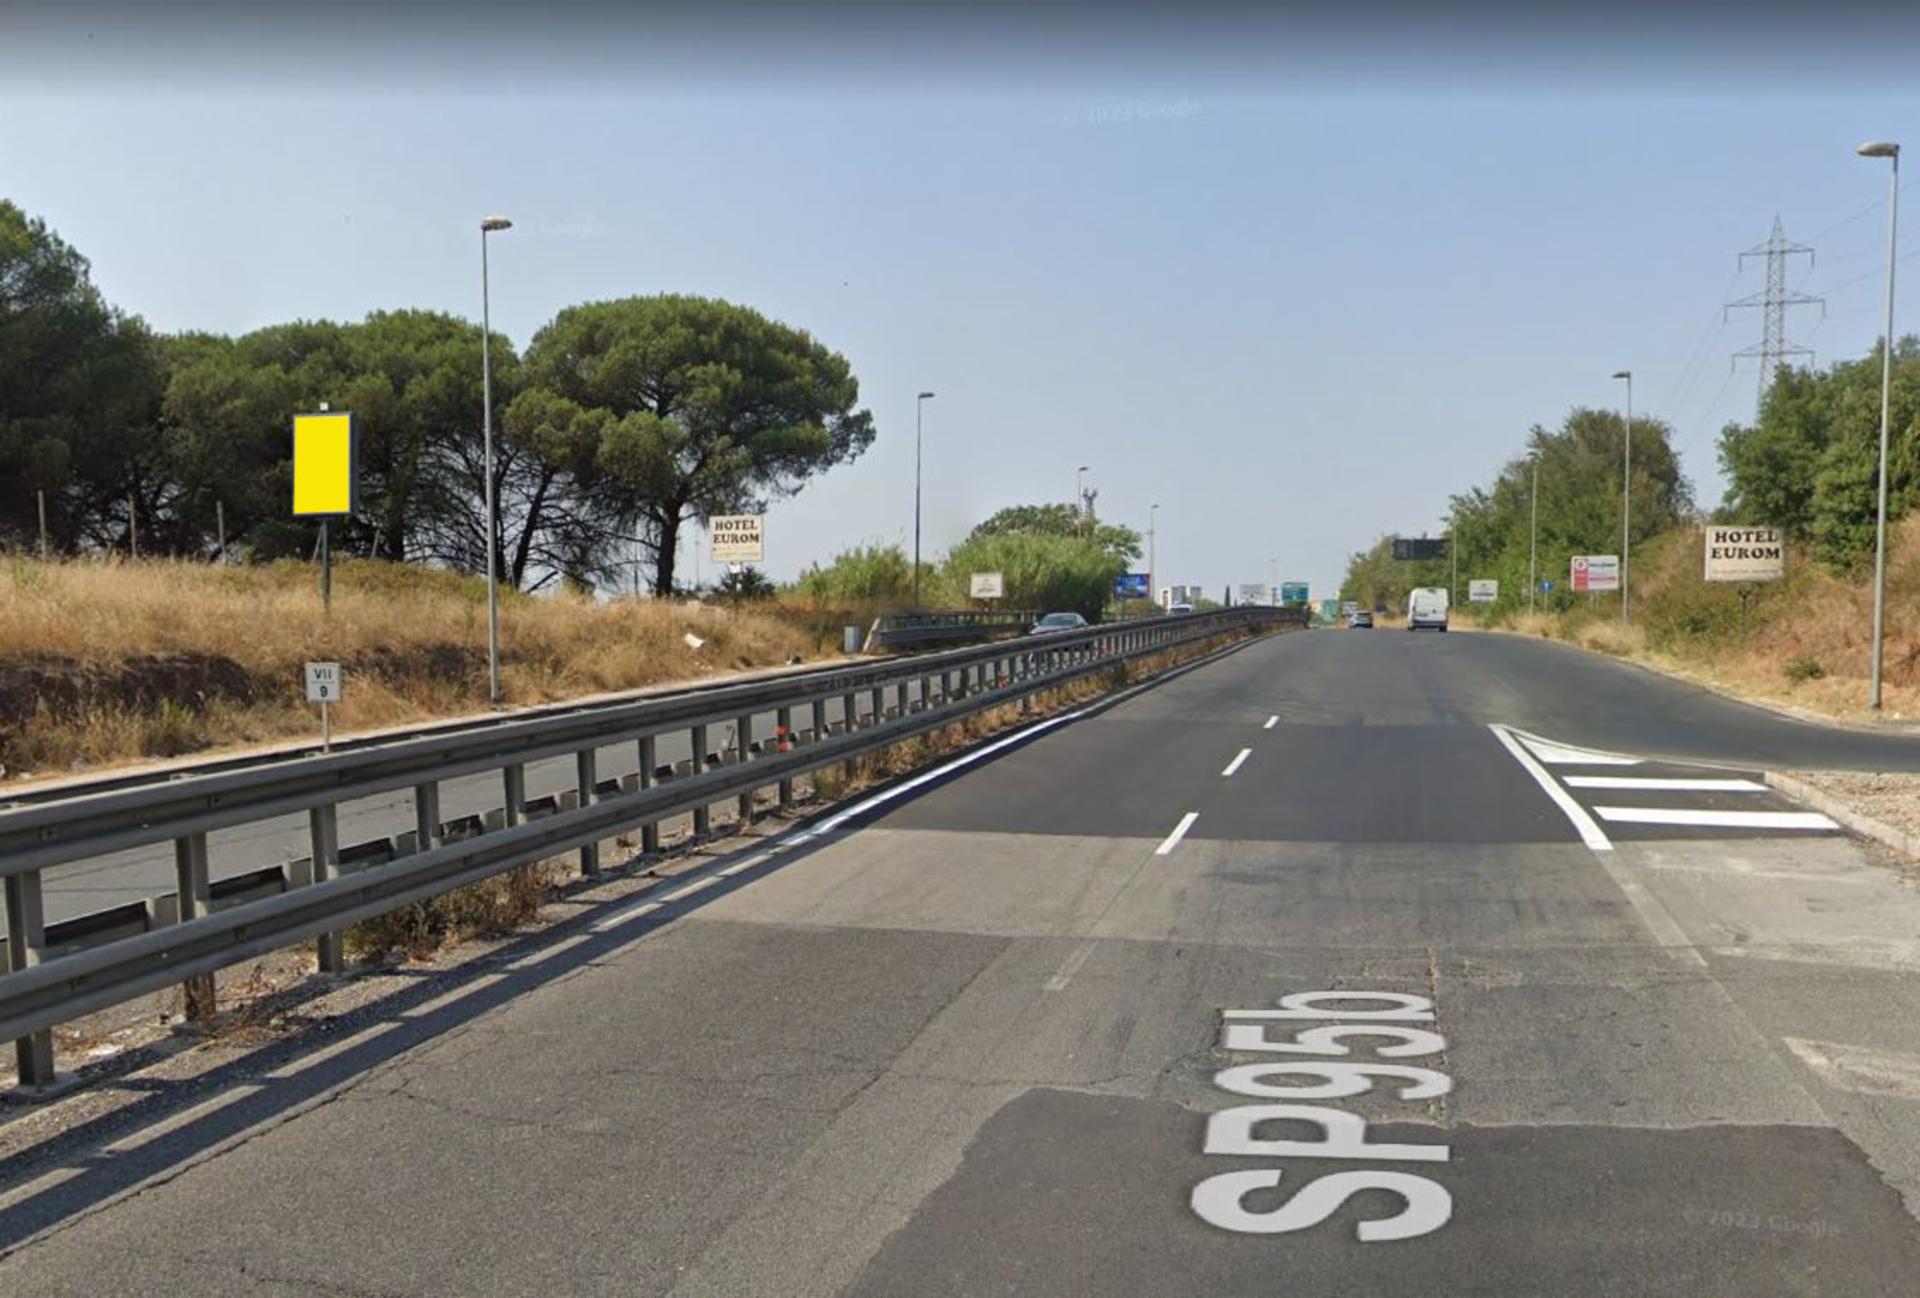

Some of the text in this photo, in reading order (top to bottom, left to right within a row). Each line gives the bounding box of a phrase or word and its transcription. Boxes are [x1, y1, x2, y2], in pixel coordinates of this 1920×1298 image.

[715, 519, 758, 531] HOTEL
[713, 533, 760, 544] EUROM
[1715, 530, 1778, 543] HOTEL
[1711, 547, 1780, 560] EUROM
[314, 668, 332, 680] VII
[319, 685, 328, 698] 9
